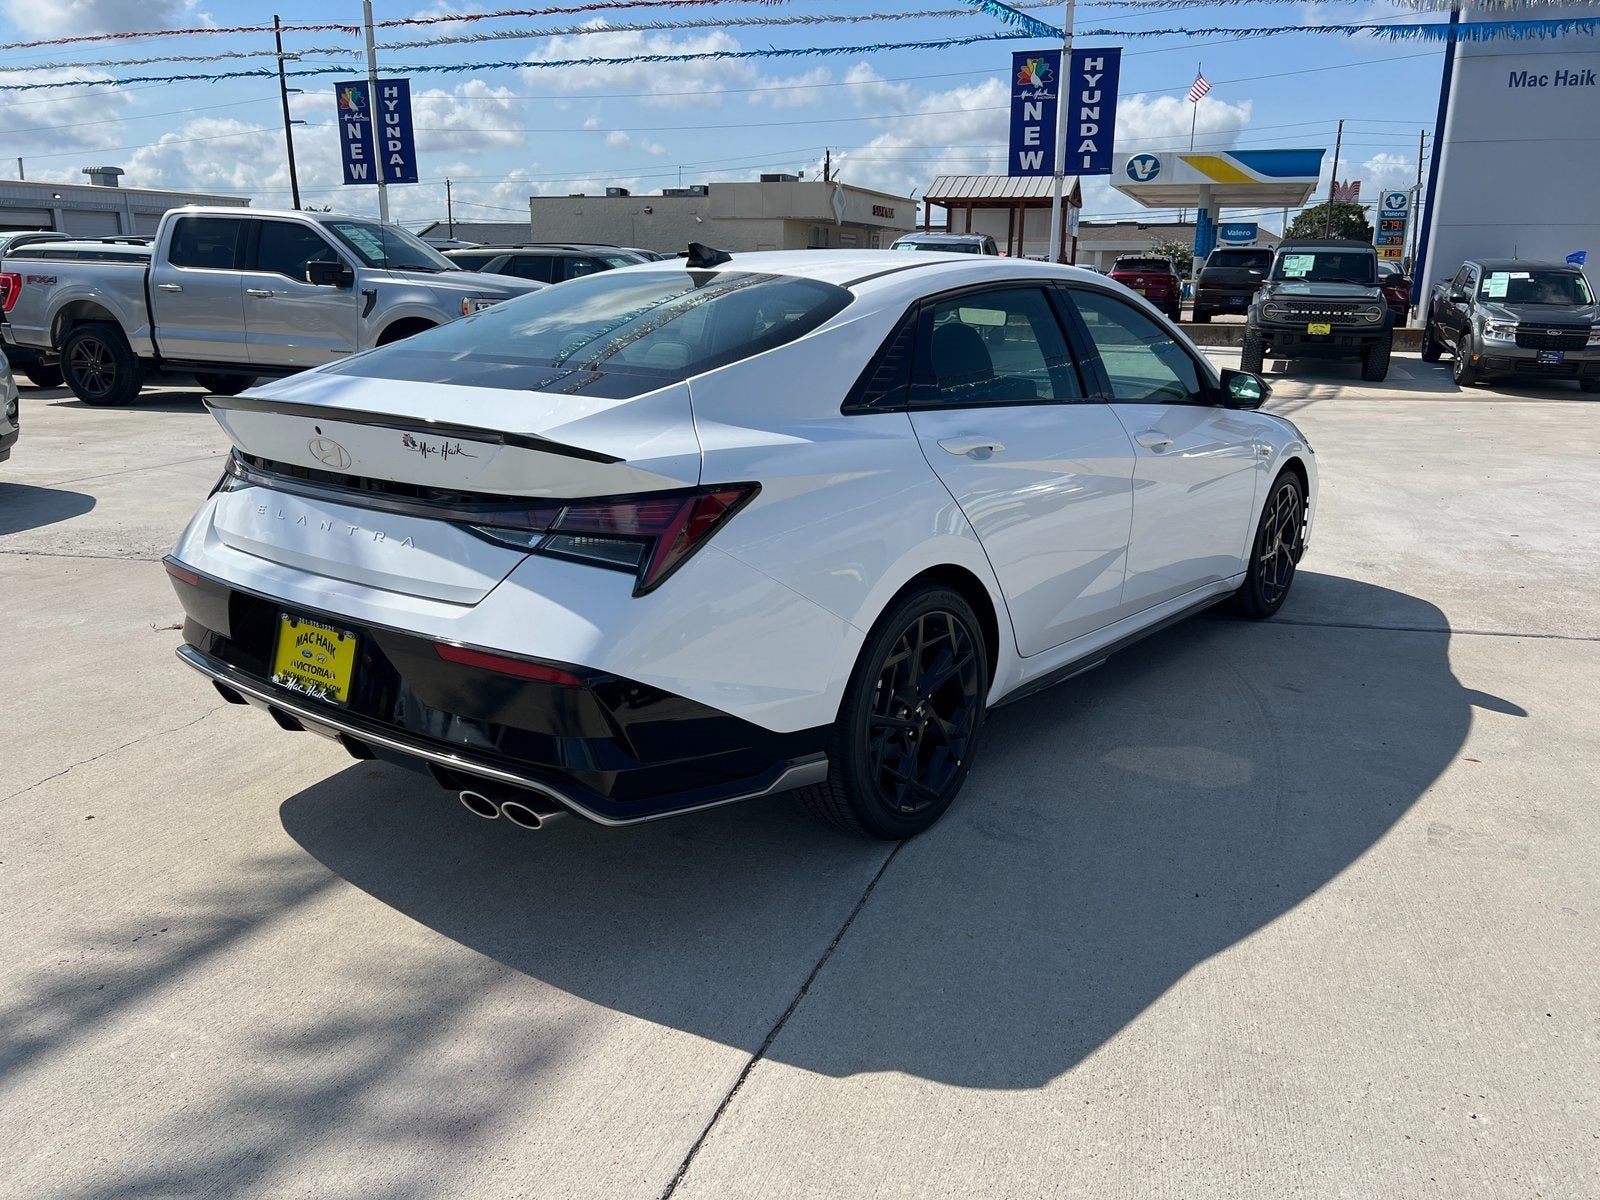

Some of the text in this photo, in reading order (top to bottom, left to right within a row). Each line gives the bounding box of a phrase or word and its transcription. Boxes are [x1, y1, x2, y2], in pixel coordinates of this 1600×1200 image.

[1509, 69, 1597, 88] Mac Haik
[1078, 57, 1104, 168] HYUNDAI
[384, 86, 405, 178] HYUNDAI
[1019, 101, 1044, 170] NEW
[347, 123, 368, 179] NEW
[26, 275, 57, 286] FX4
[415, 441, 474, 460] Mac Haik
[257, 505, 415, 549] ELANTRA
[296, 632, 337, 659] MAC HAIK
[296, 661, 330, 679] VICTORIA
[284, 678, 334, 702] Mac Haik
